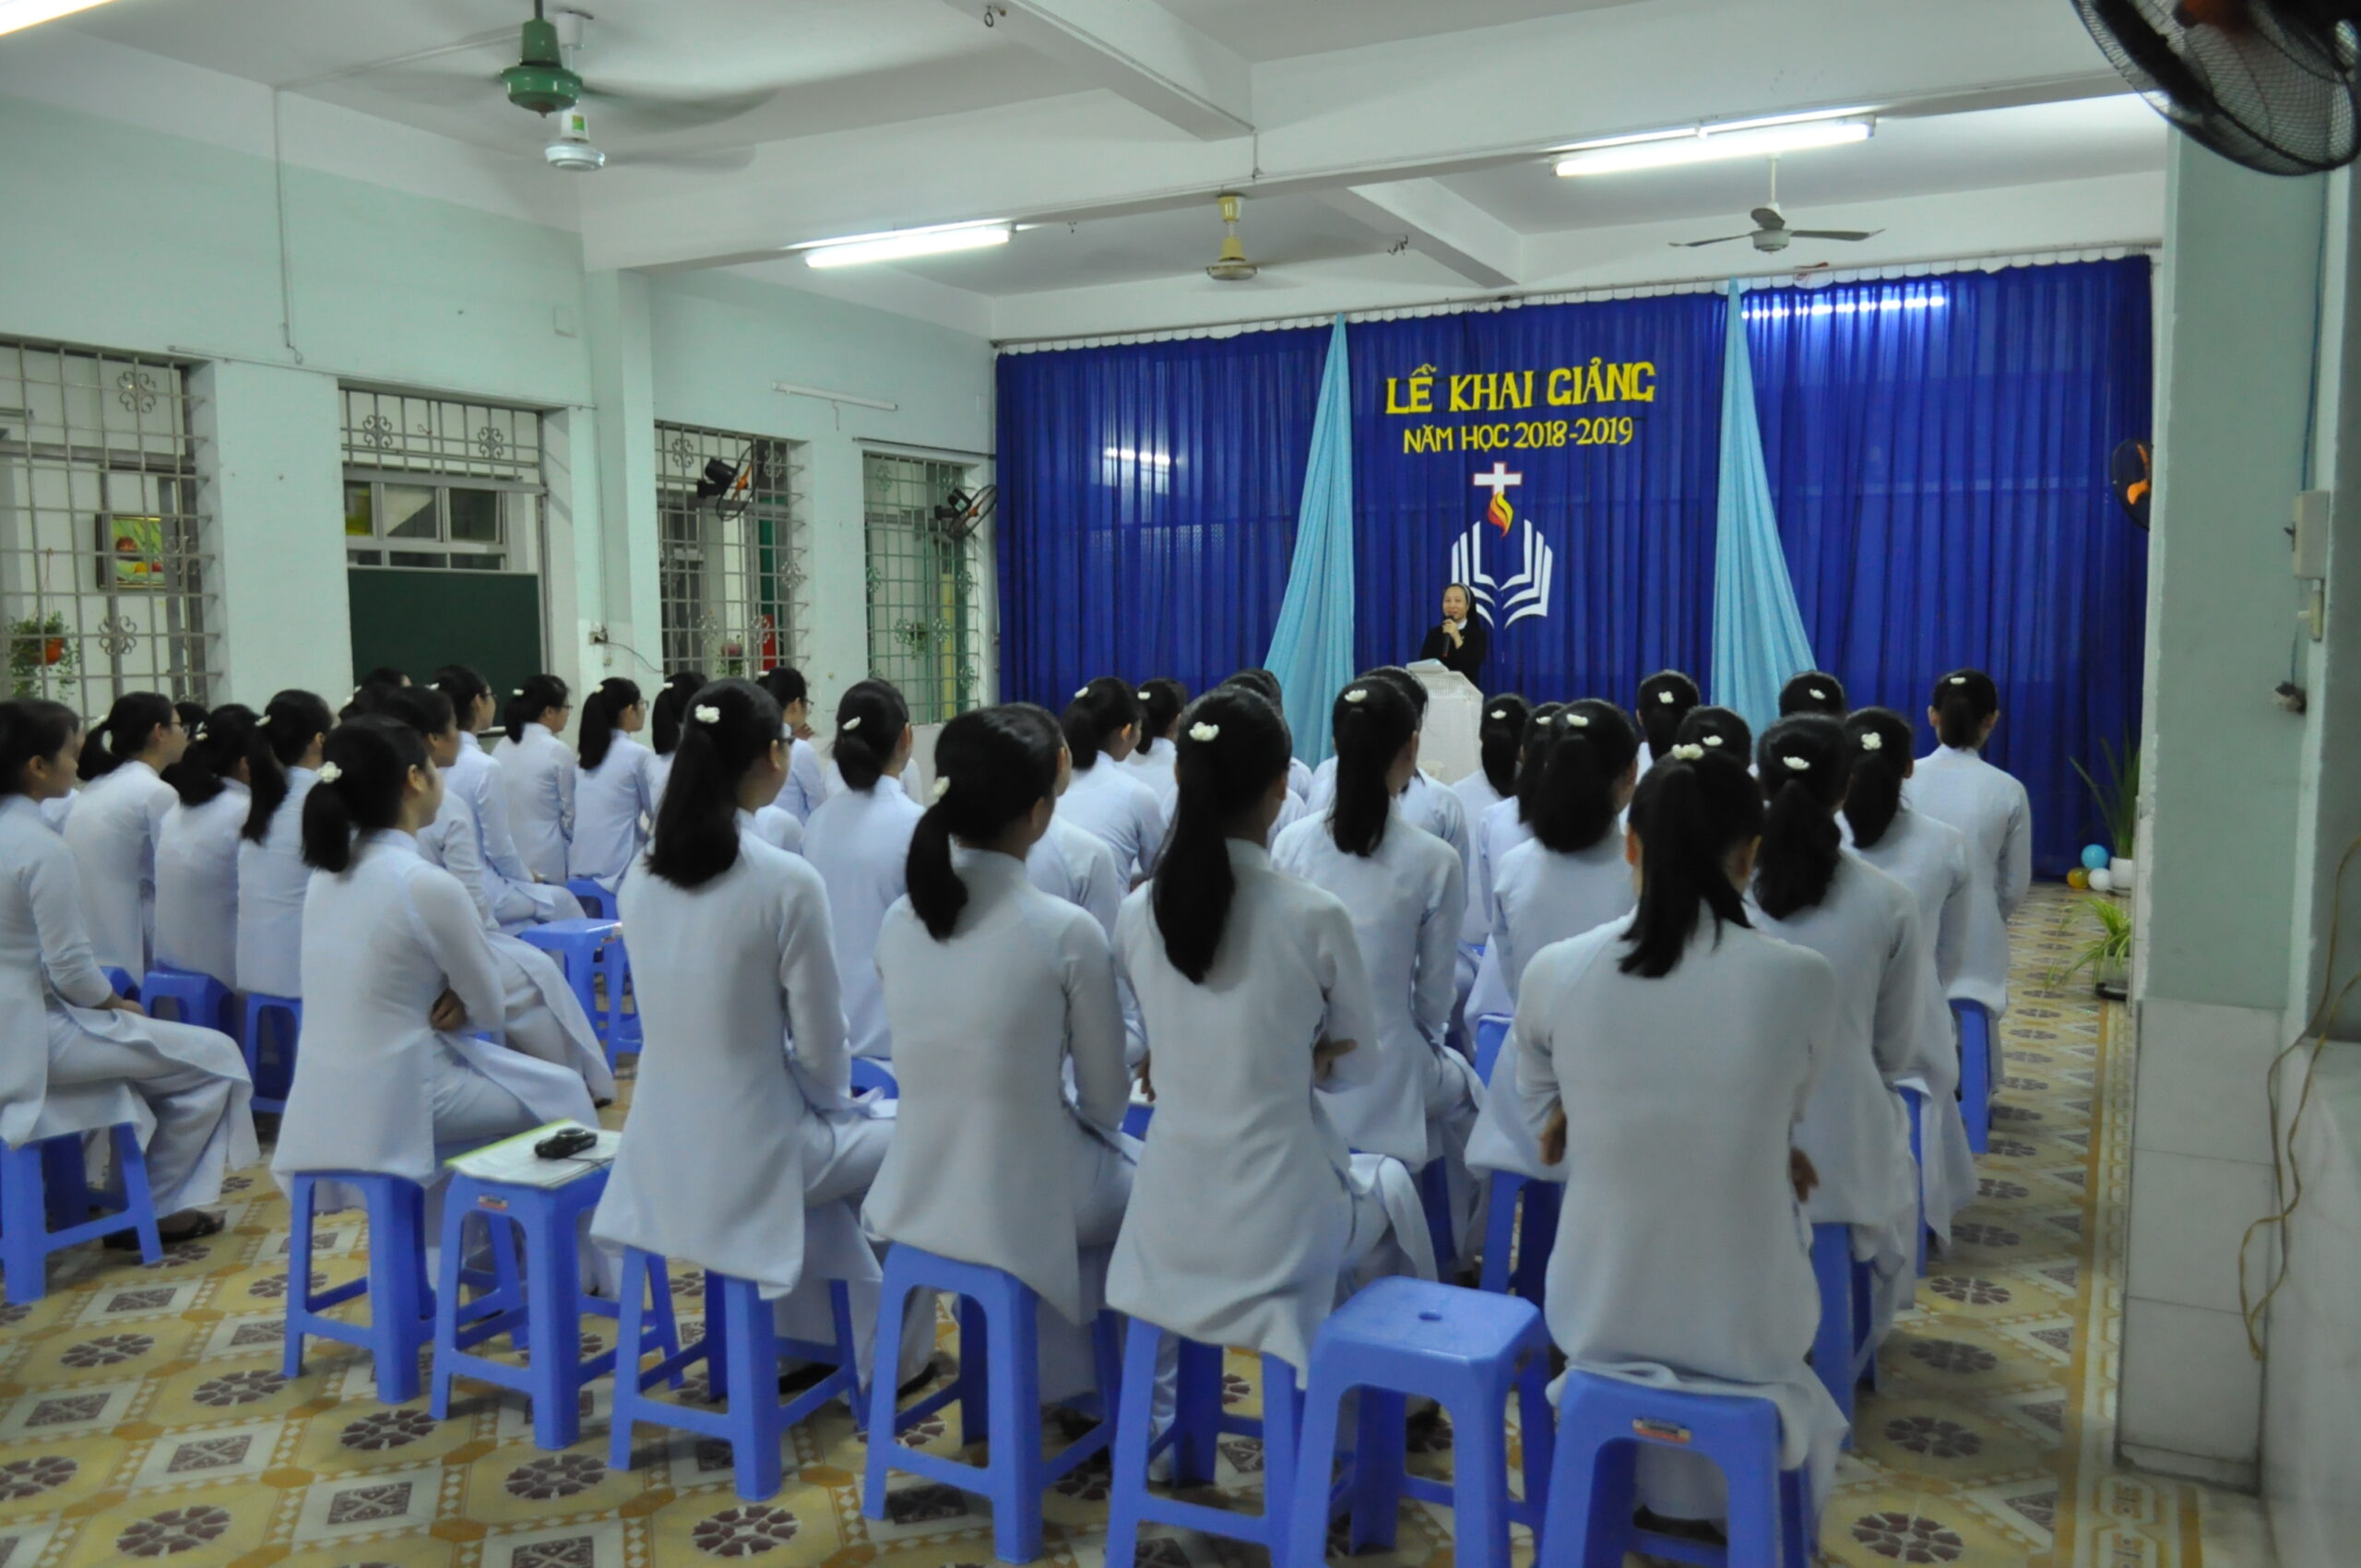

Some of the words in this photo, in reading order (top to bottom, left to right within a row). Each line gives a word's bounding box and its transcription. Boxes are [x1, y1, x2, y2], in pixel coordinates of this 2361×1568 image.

[1385, 362, 1437, 414] LỄ
[1449, 370, 1535, 412] KHAI
[1547, 356, 1656, 407] GIẢNG
[1403, 424, 1453, 454] NĂM
[1460, 422, 1510, 453] HỌC
[1513, 416, 1633, 449] 2018-2019
